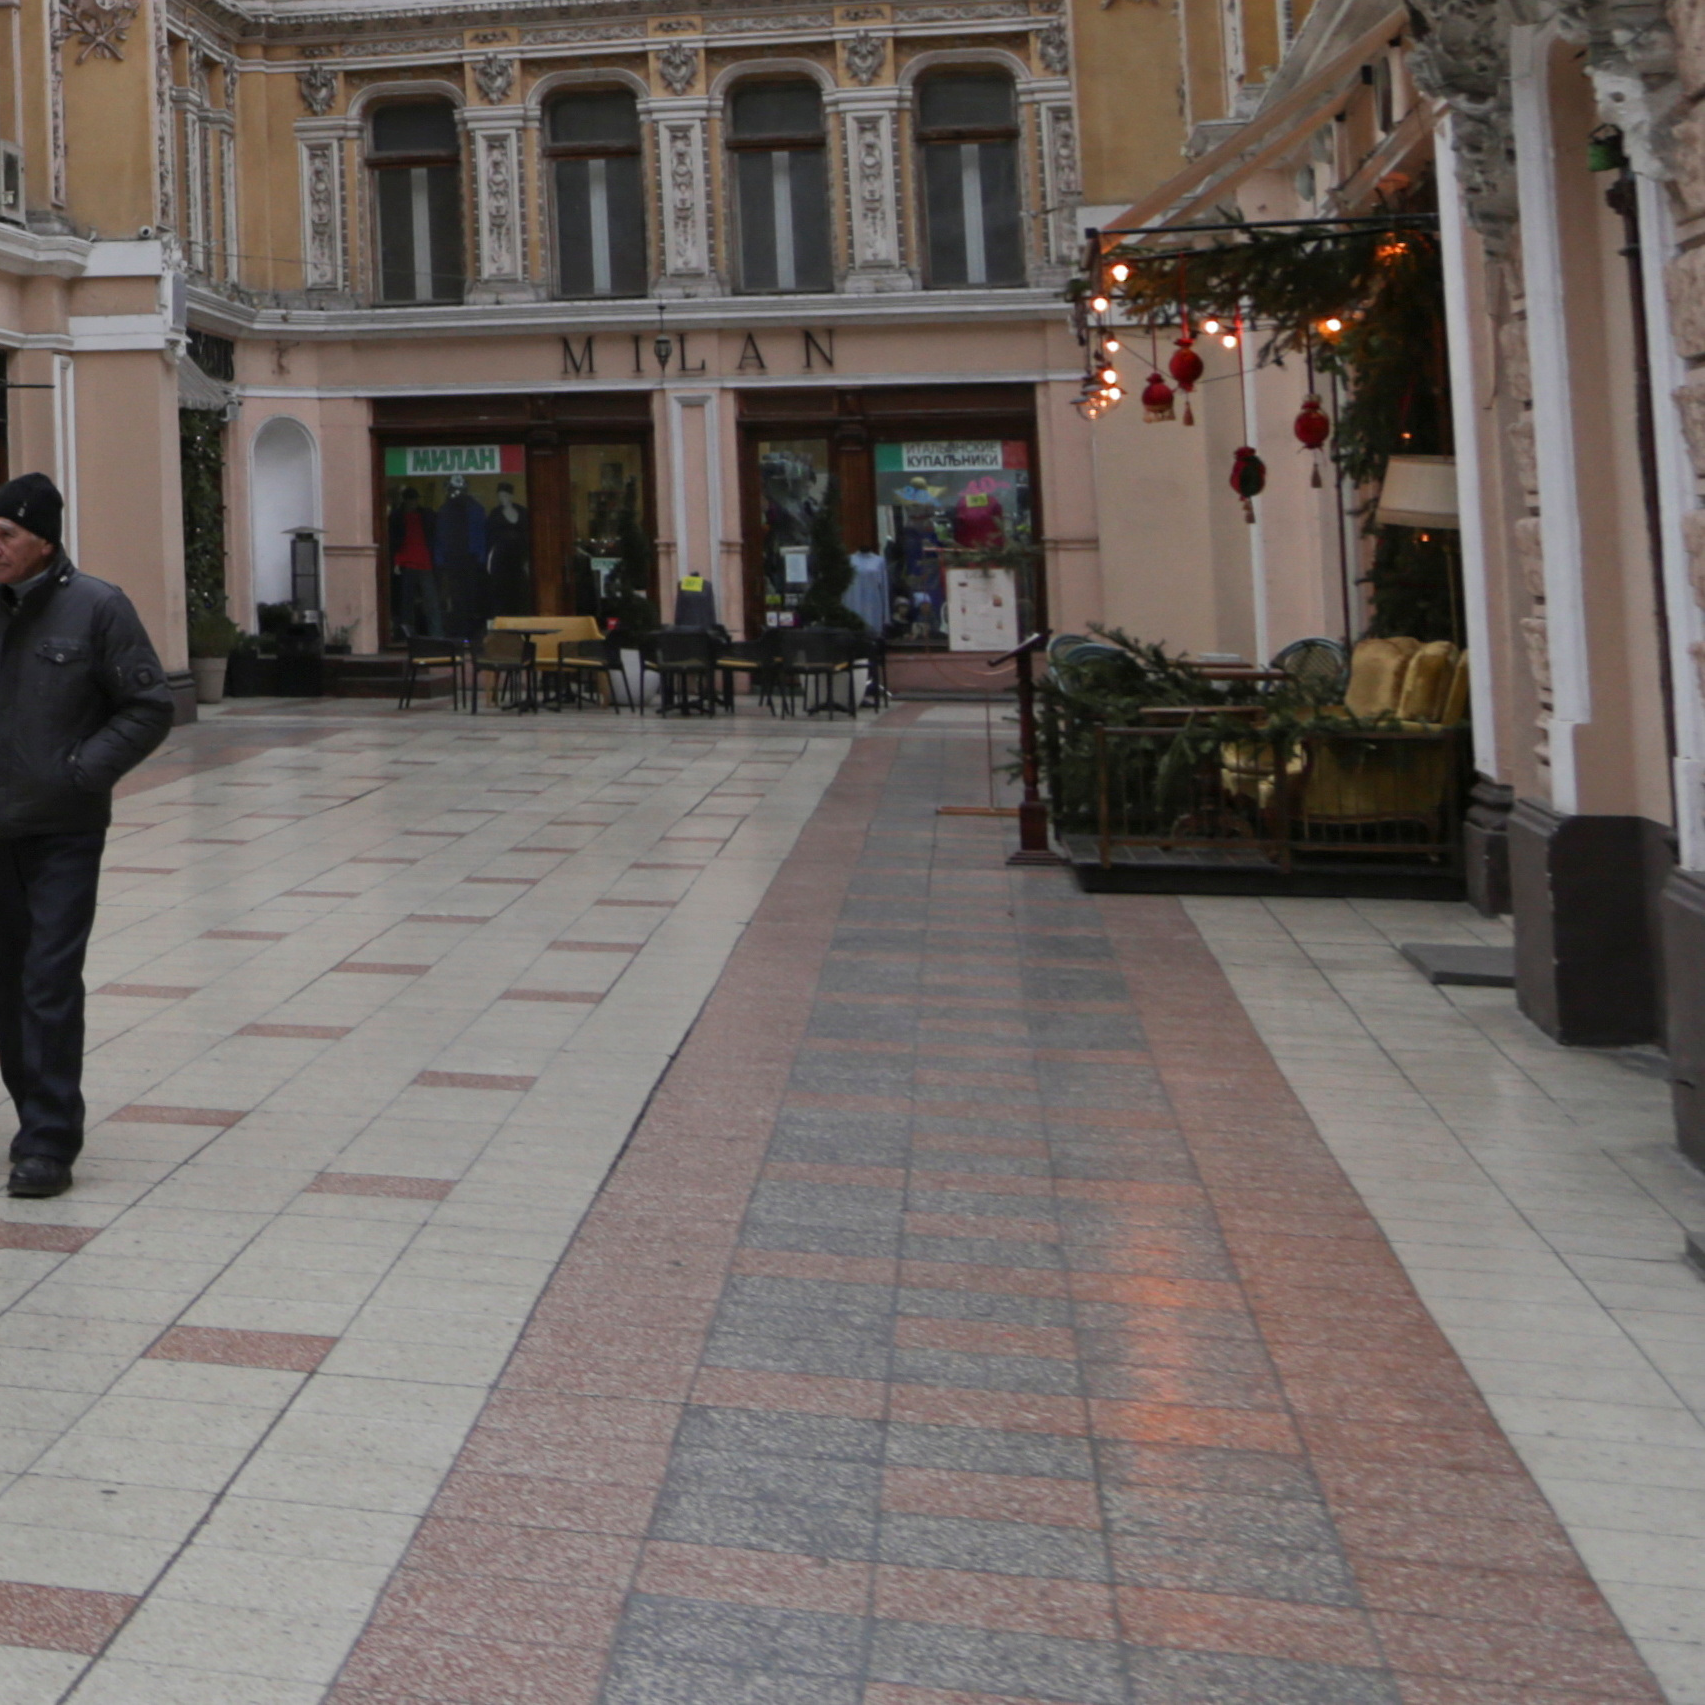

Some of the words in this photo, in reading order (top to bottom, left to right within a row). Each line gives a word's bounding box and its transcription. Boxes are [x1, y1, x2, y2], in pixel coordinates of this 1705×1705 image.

[561, 328, 837, 375] MILAN
[412, 448, 495, 472] МИЛАН
[907, 454, 999, 467] КУПАЛЬНИКИ
